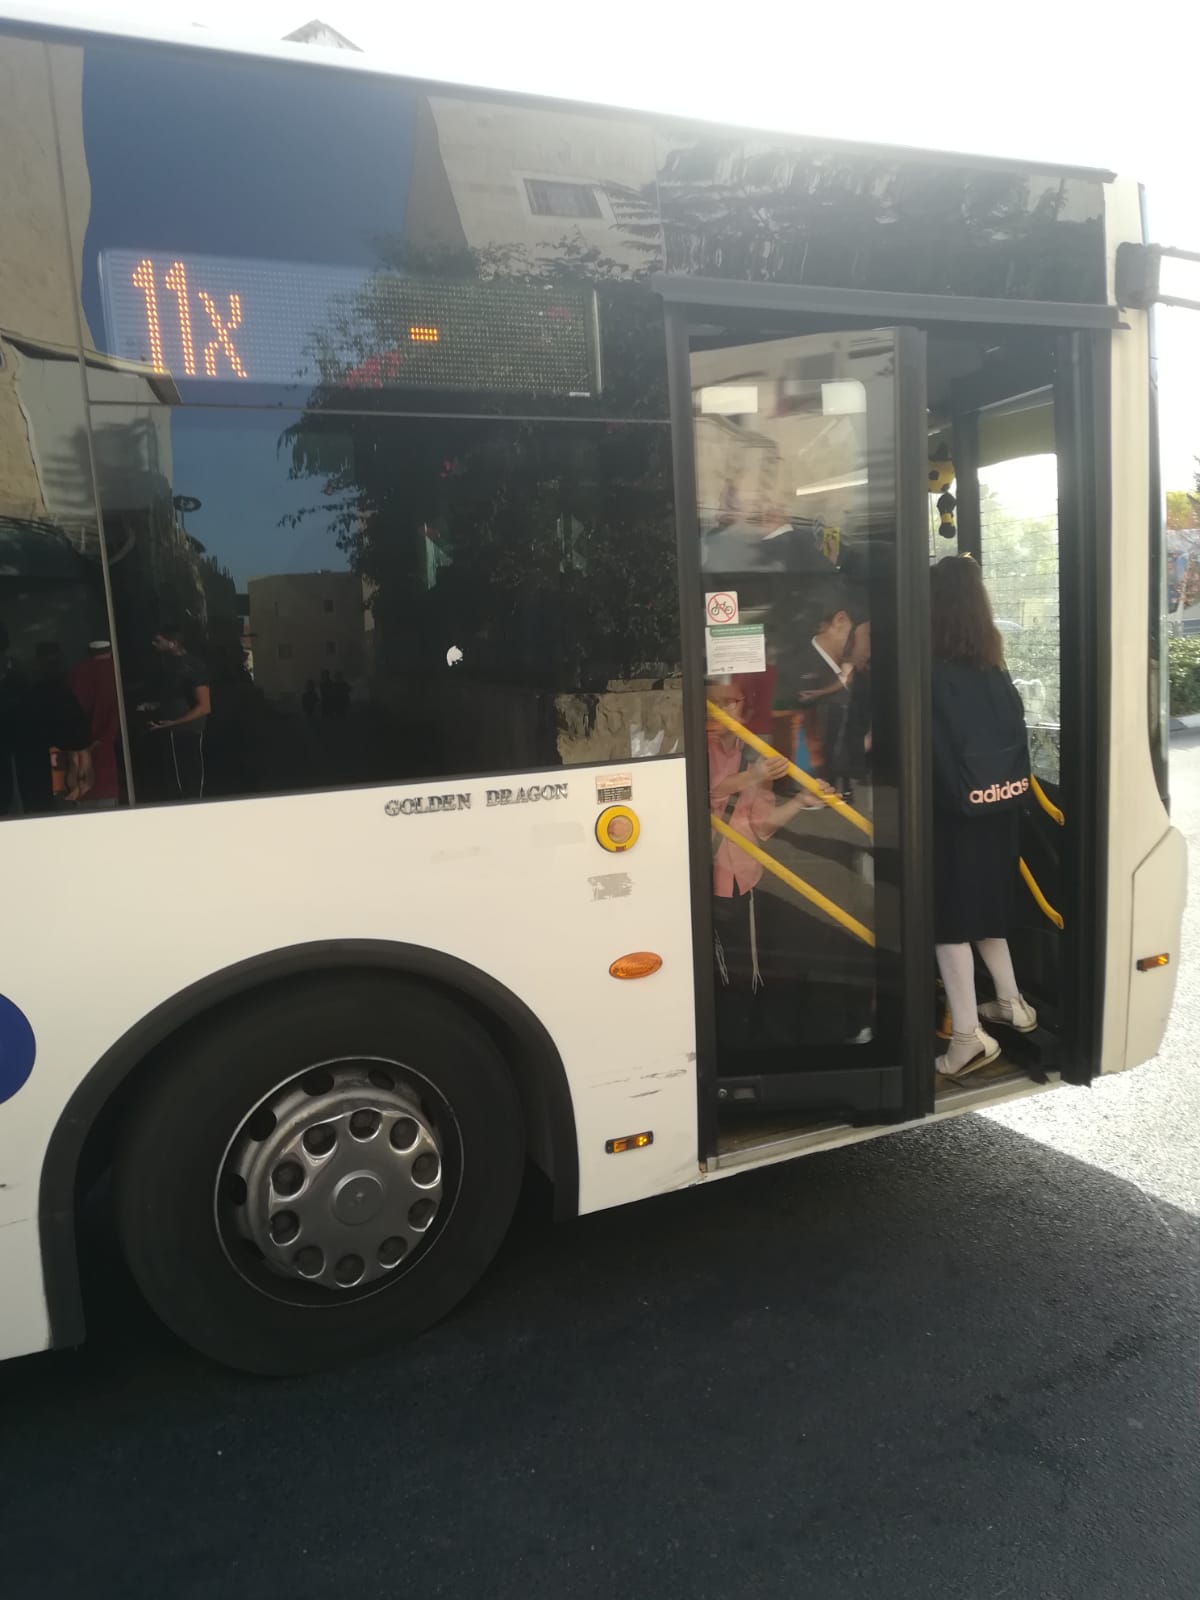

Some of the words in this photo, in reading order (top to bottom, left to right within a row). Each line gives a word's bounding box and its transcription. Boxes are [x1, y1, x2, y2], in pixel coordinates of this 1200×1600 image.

[384, 792, 472, 816] GOLDEN
[485, 783, 569, 807] DRAGON
[969, 778, 1029, 804] adidas
